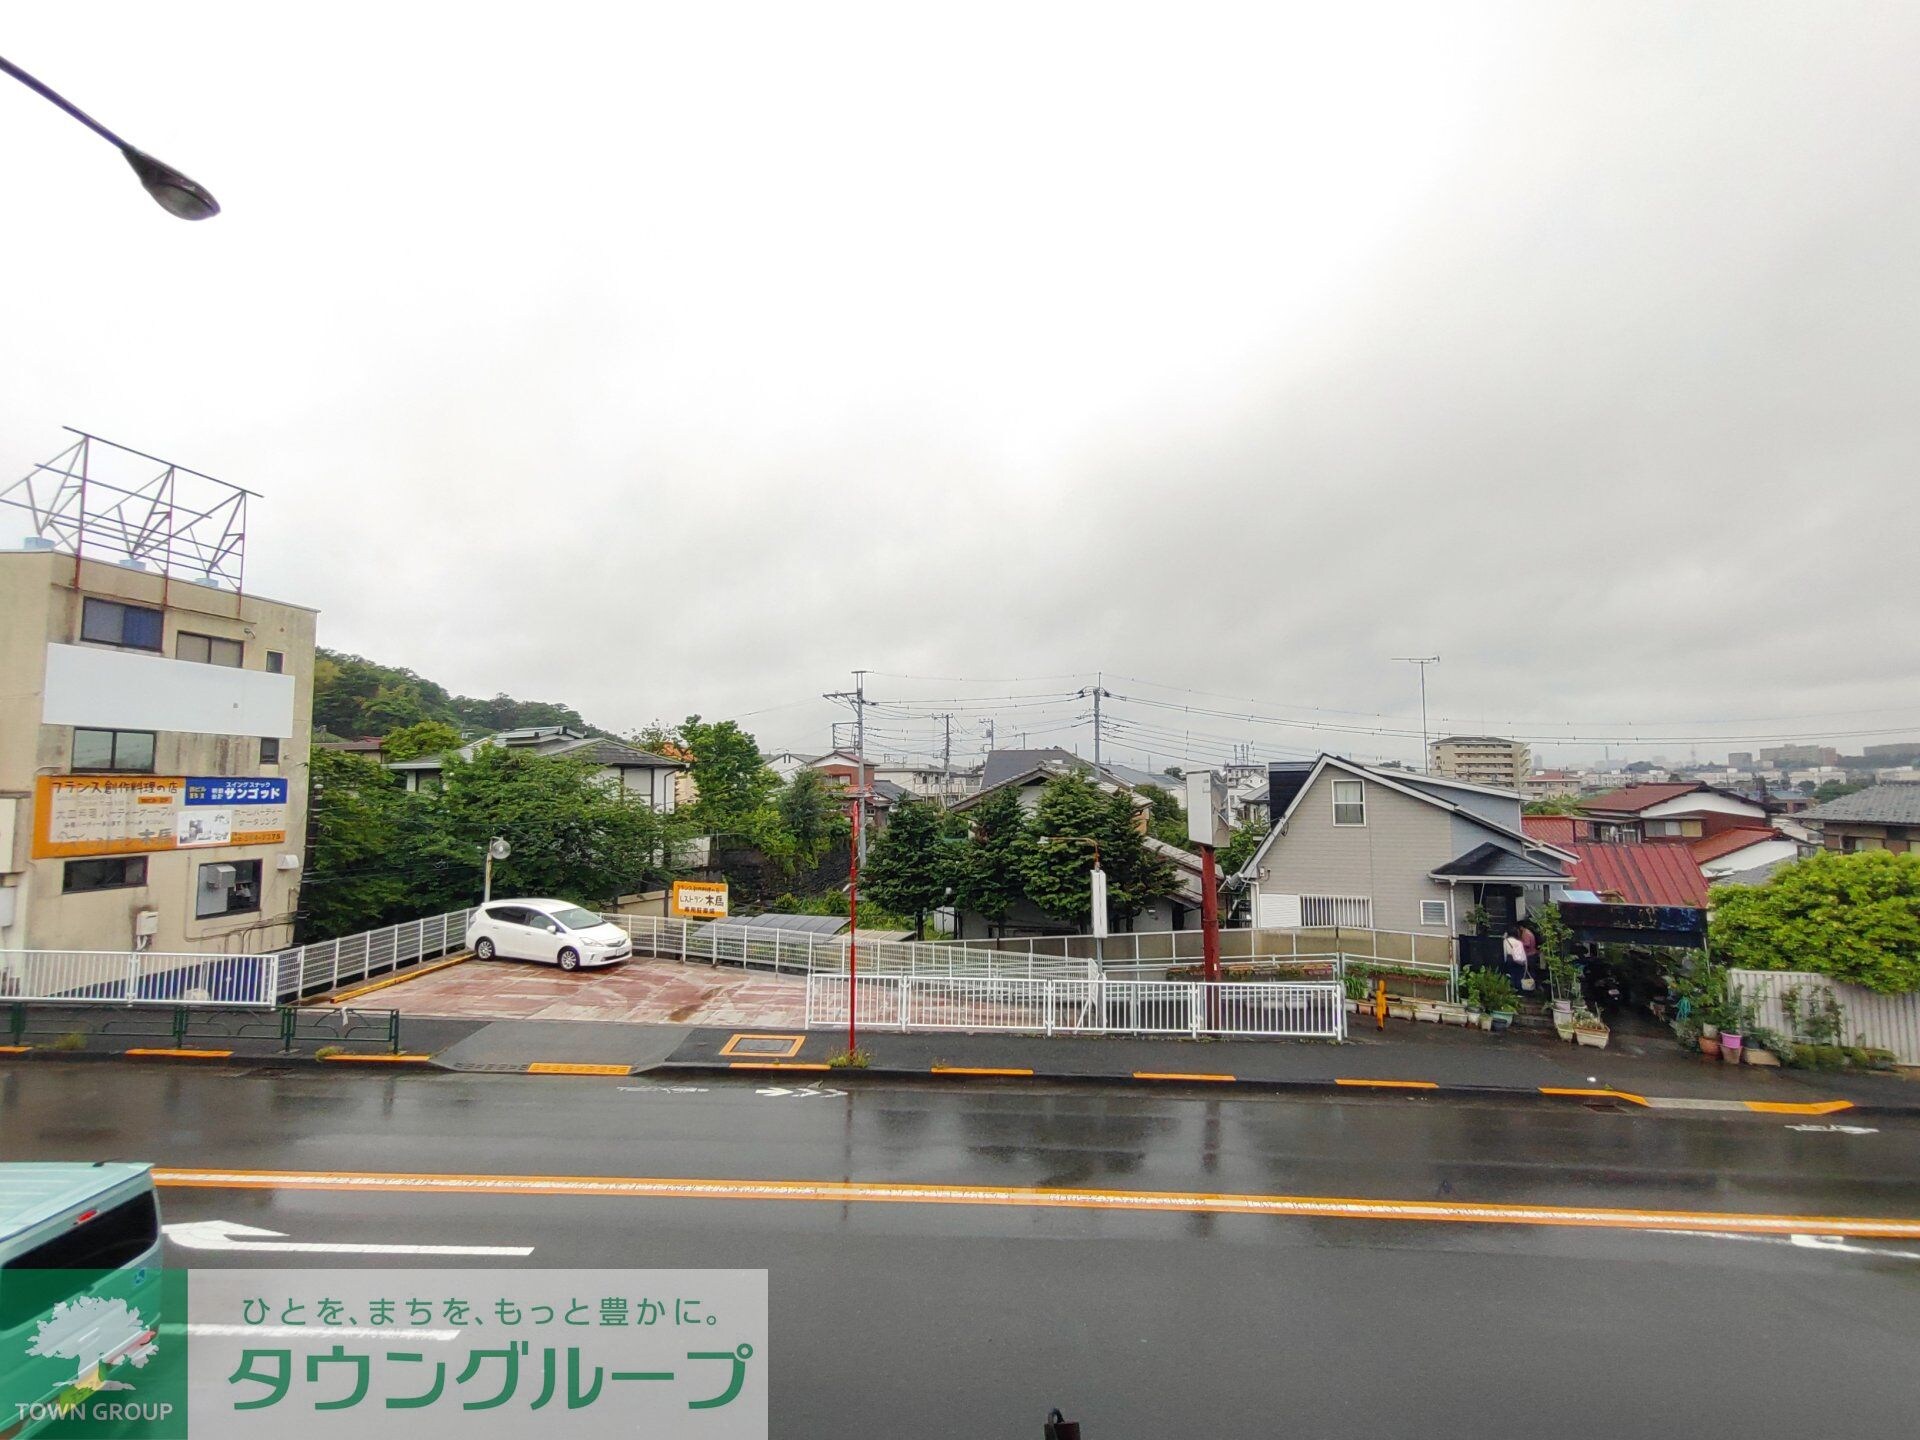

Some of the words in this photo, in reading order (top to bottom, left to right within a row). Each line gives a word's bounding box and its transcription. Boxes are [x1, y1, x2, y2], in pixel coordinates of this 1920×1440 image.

[52, 780, 178, 794] フランス創作料理の店
[225, 787, 280, 800] サンゴッド
